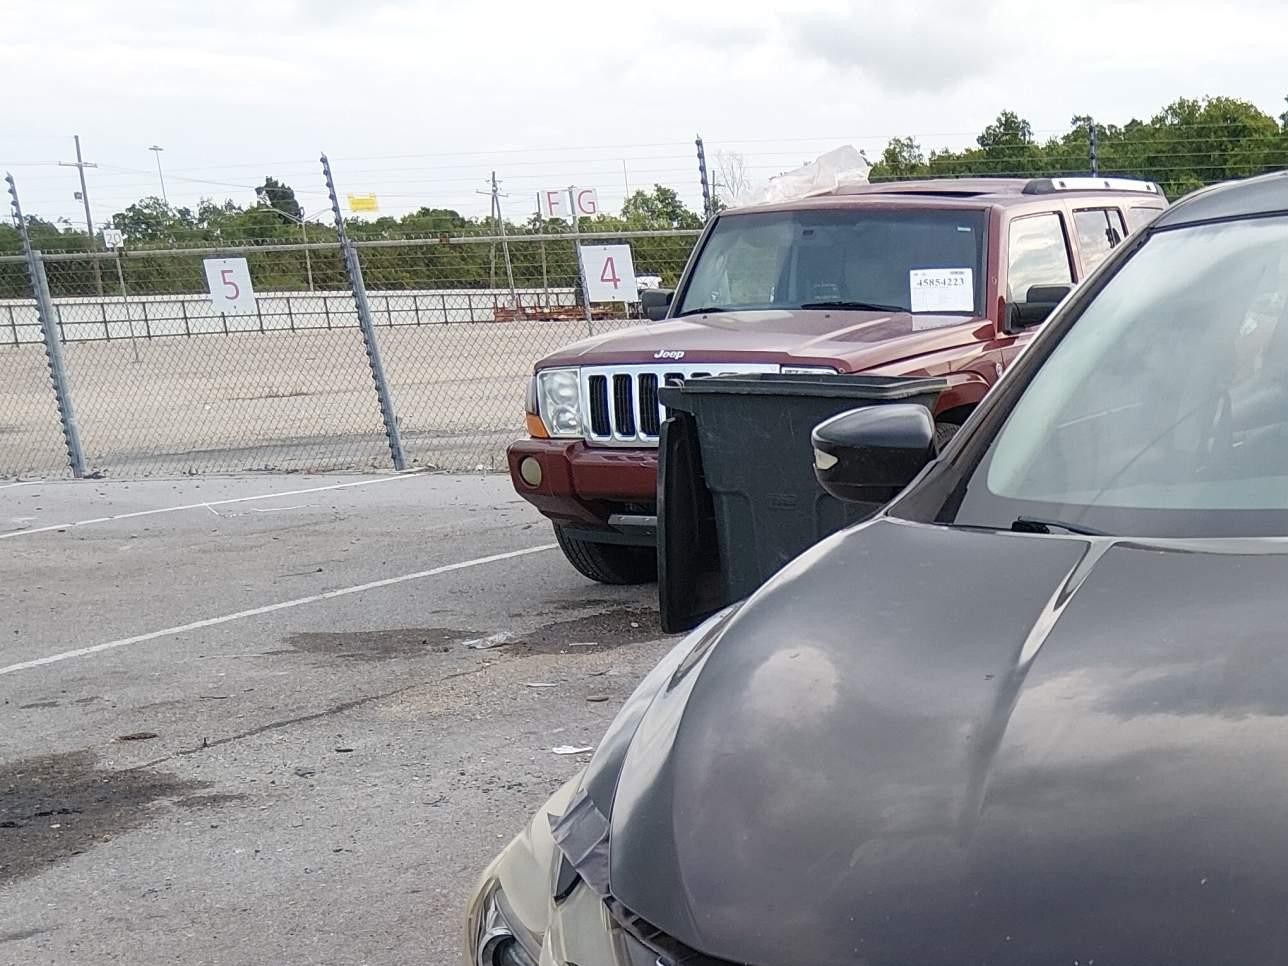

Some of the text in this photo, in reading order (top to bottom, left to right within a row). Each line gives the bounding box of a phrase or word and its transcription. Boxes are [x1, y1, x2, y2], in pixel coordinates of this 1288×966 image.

[547, 191, 559, 216] F
[577, 189, 597, 215] G
[220, 269, 240, 300] 5
[600, 256, 621, 289] 4
[653, 349, 685, 360] Jeep
